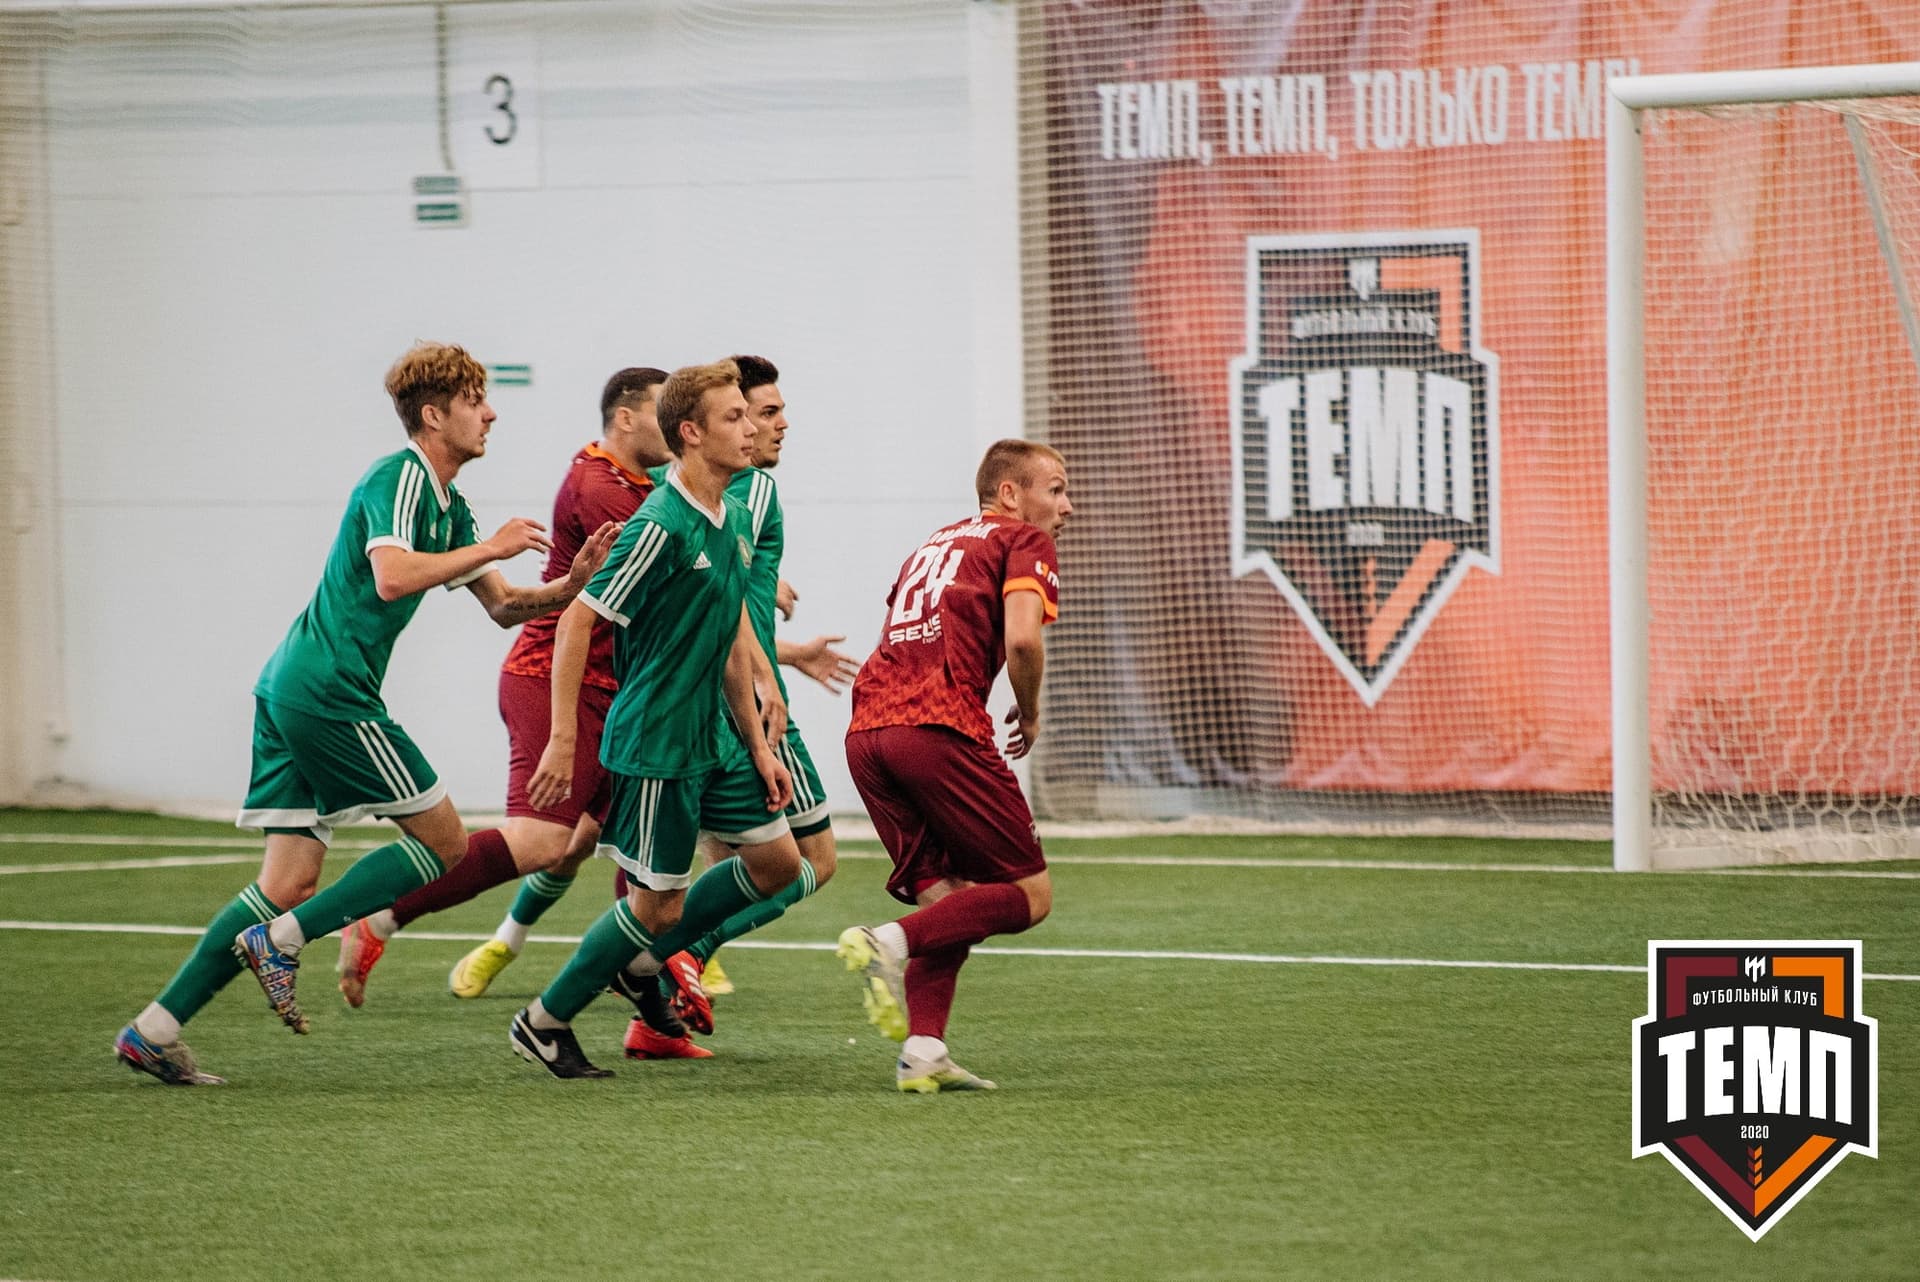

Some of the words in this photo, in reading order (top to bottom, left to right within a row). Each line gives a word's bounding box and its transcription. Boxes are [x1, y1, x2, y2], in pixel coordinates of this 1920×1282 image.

[484, 73, 517, 146] 3
[1097, 79, 1213, 166] ТЕМП,
[1219, 73, 1339, 161] ТЕМП,
[1350, 65, 1508, 151] ТОЛЬКО
[1520, 57, 1640, 141] ТЕМ
[1257, 366, 1473, 525] ТЕМП
[889, 541, 965, 627] 24
